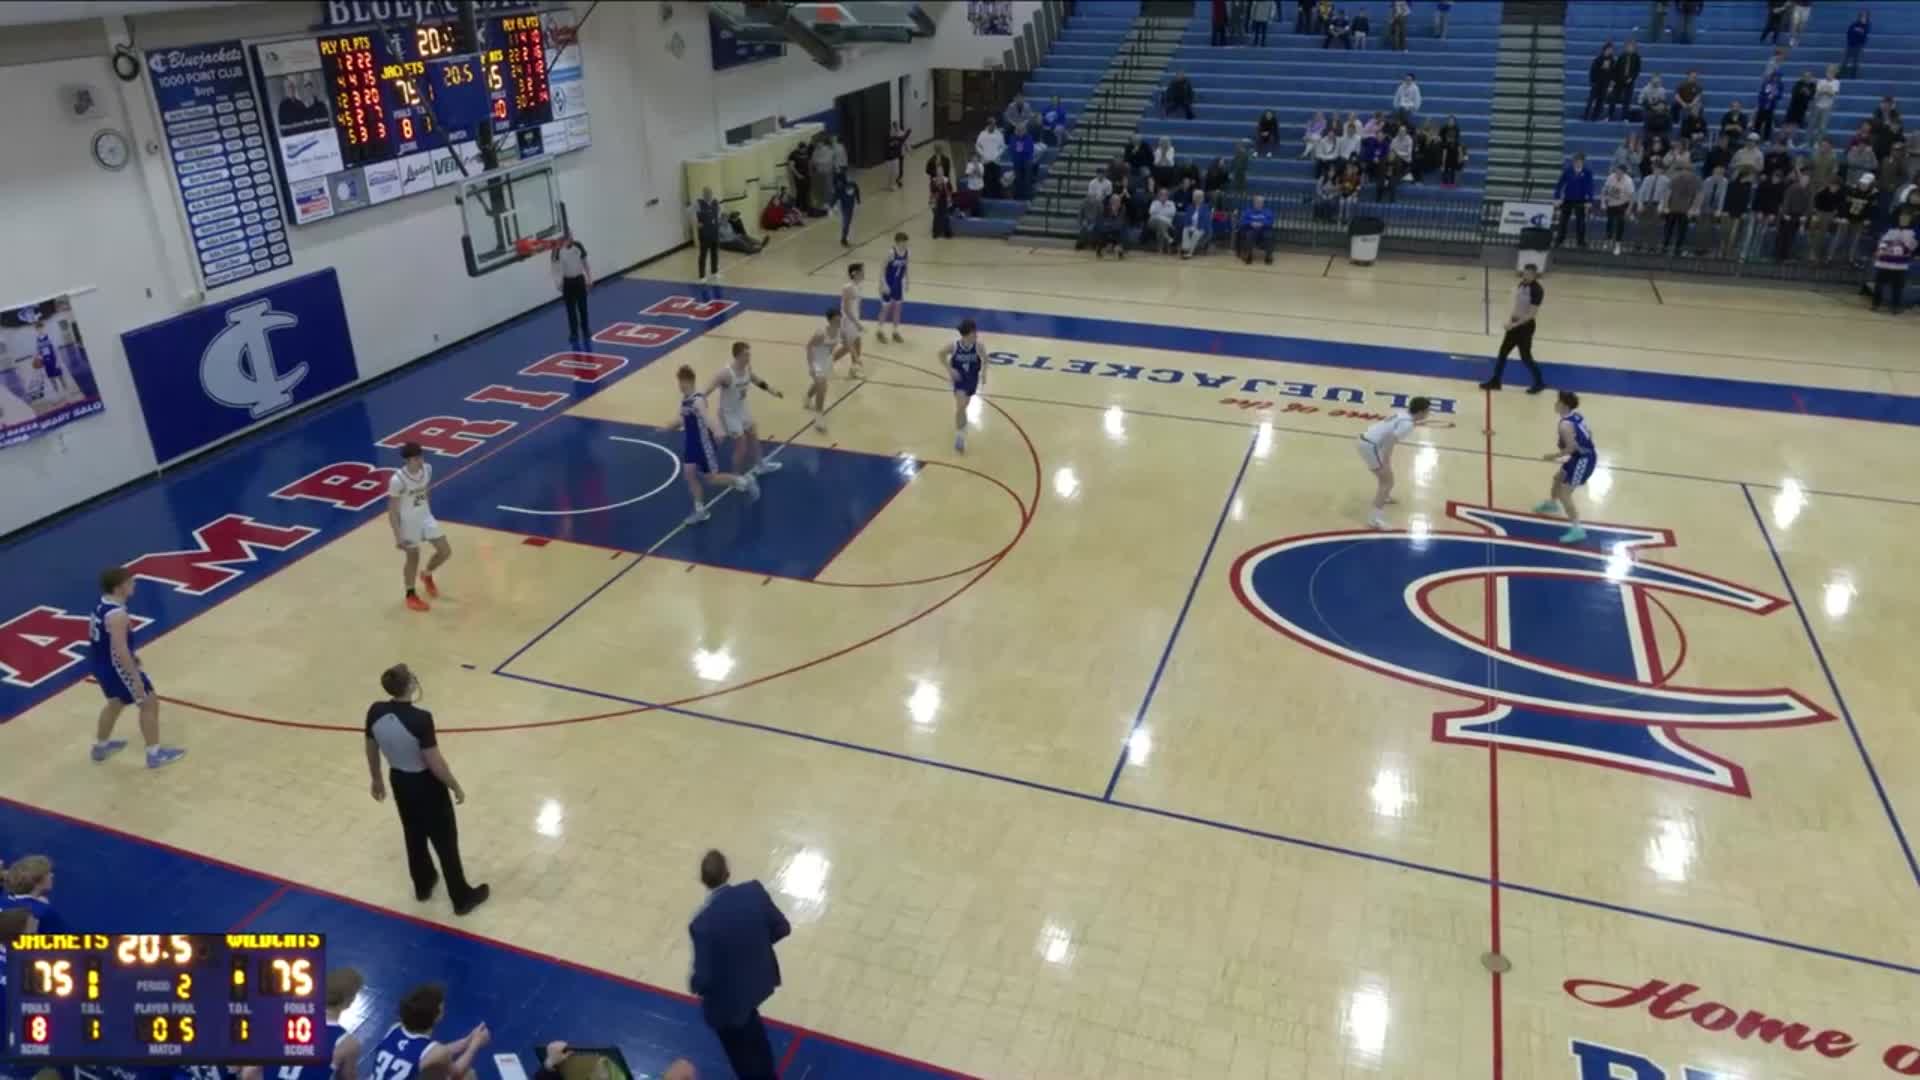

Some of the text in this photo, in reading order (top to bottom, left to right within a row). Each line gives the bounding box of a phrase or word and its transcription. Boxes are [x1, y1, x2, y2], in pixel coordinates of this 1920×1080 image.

[320, 36, 371, 54] PLY FL PTS
[168, 47, 241, 69] Bluejackets
[357, 51, 372, 69] 22
[443, 63, 474, 87] 20.5
[351, 90, 362, 107] 3
[363, 87, 380, 105] 20
[360, 125, 369, 142] 3
[377, 122, 386, 138] 3
[402, 117, 414, 139] 8
[1563, 978, 1861, 1058] Home
